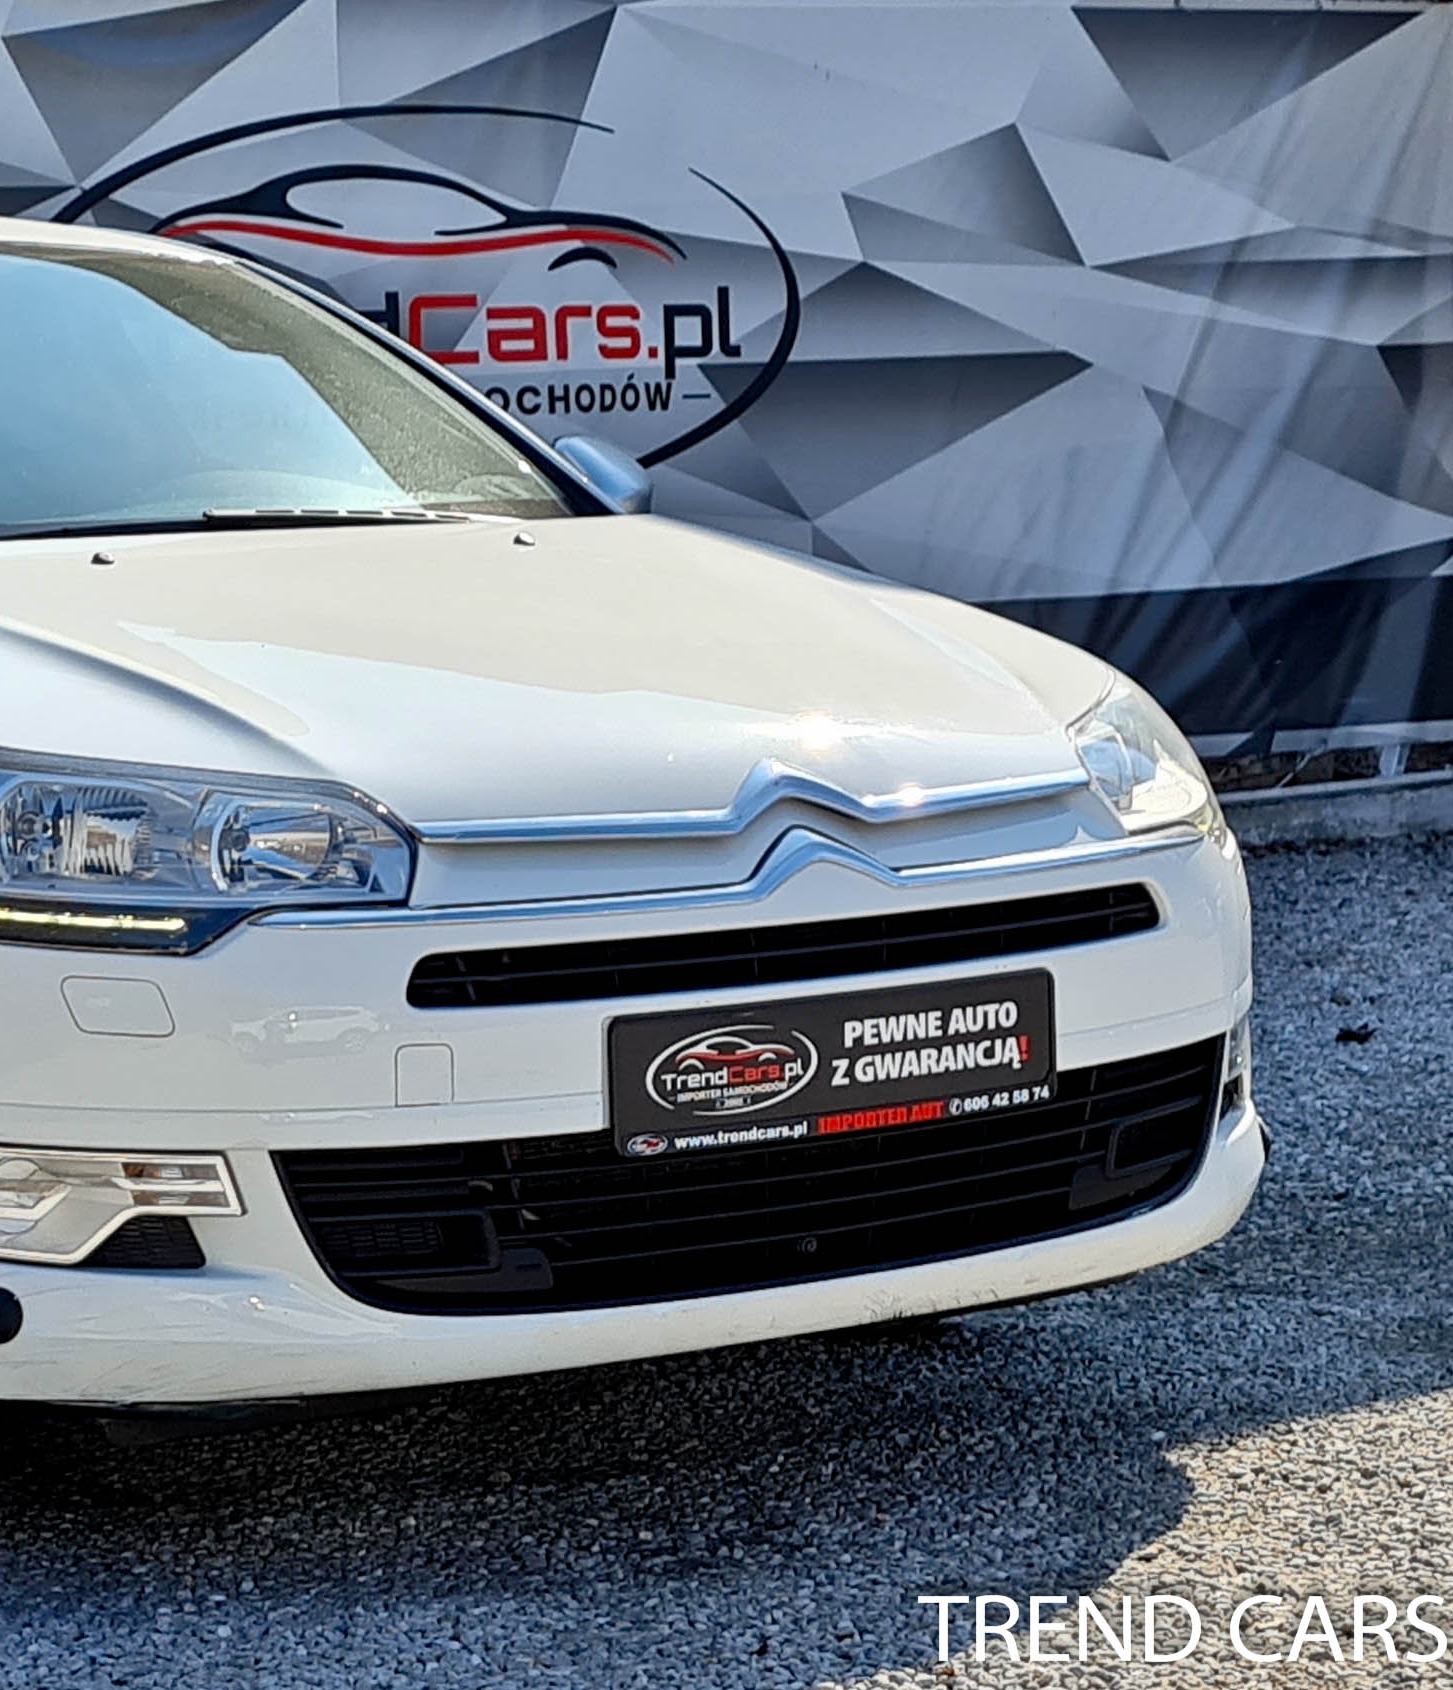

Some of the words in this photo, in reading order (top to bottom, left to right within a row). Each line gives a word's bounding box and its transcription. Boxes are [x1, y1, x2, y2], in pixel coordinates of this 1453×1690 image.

[843, 1009, 944, 1049] PEWNE
[947, 1000, 1019, 1036] AUTO
[660, 1056, 805, 1092] TrendCars.pl
[830, 1057, 851, 1088] Z
[853, 1034, 1030, 1083] GWARANCJĄ!
[991, 1090, 1010, 1108] 42
[1032, 1084, 1050, 1101] 74
[674, 1120, 809, 1150] www.trendcars.pl
